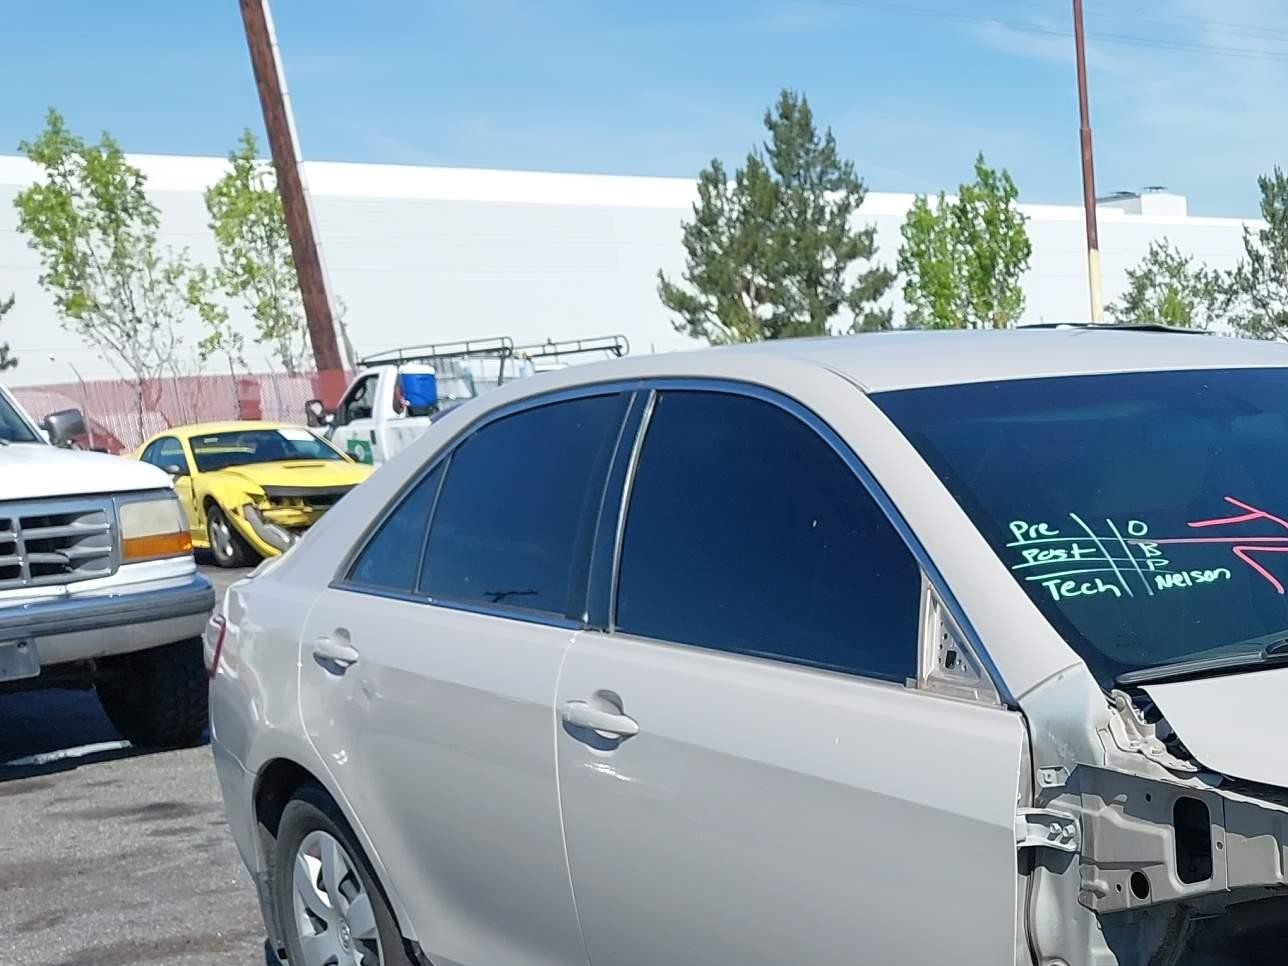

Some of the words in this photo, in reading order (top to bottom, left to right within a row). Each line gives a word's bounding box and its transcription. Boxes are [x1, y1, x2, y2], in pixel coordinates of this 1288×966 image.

[1009, 520, 1060, 542] Pre
[1021, 543, 1097, 565] Post
[1042, 578, 1122, 601] Tech
[1154, 567, 1231, 591] Nelson
